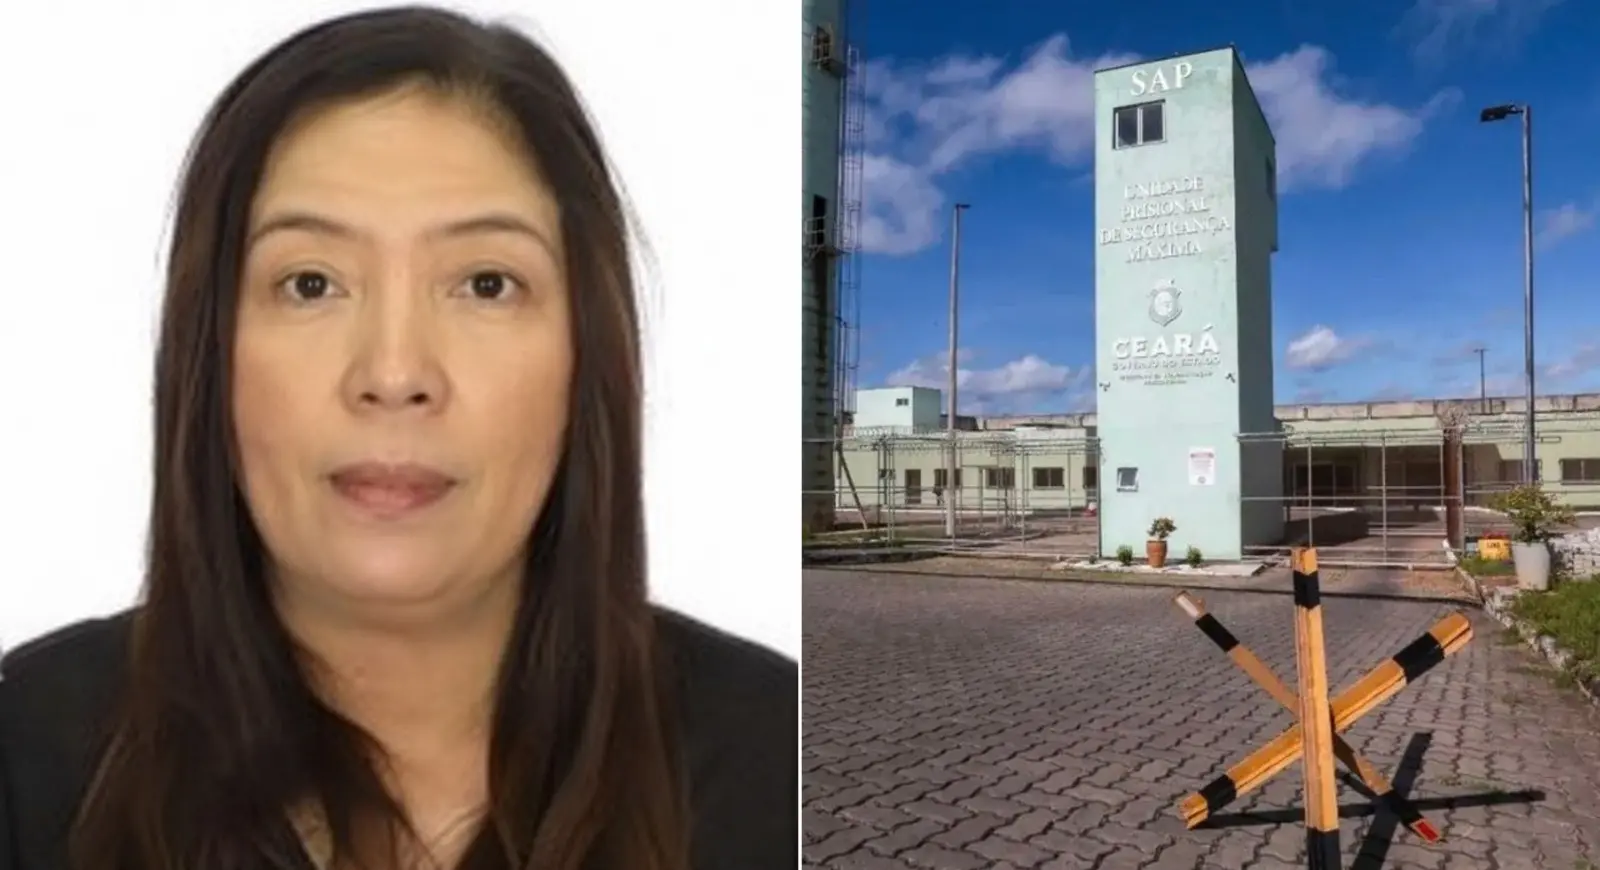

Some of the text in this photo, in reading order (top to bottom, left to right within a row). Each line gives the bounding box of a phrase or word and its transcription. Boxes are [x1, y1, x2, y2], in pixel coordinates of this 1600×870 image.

[1130, 61, 1193, 96] SAP
[1123, 177, 1203, 199] UNIDADE
[1121, 197, 1209, 223] PRISIONAL
[1100, 217, 1231, 246] DE SEGURANÇA
[1125, 241, 1201, 263] MÁXIMA
[1112, 324, 1221, 359] CEARÁ
